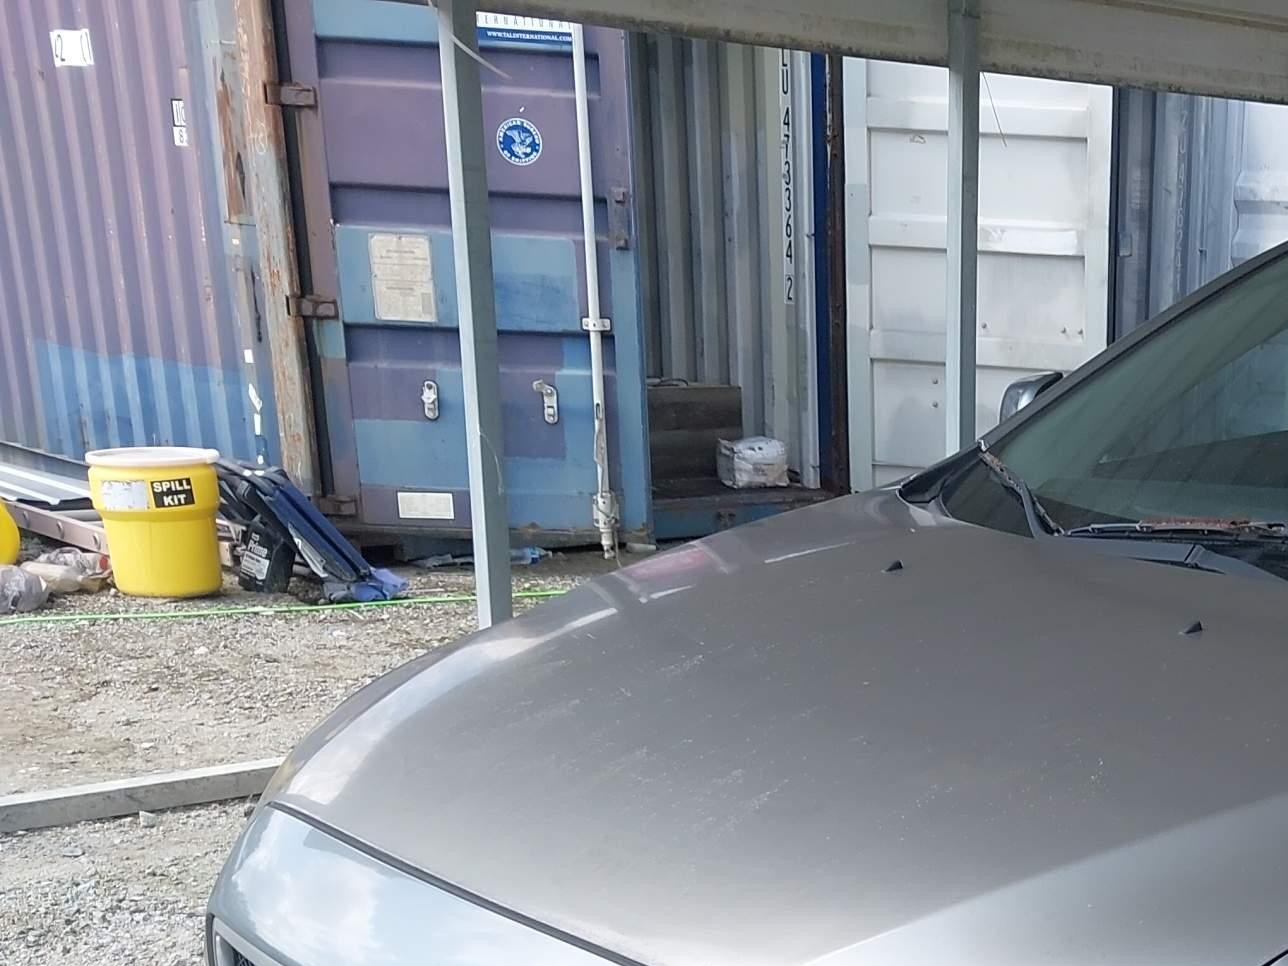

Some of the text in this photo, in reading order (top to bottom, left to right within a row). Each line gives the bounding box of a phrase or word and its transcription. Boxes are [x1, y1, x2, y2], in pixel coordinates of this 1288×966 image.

[783, 107, 793, 265] 473364
[153, 479, 191, 493] SPILL
[163, 494, 187, 506] KIT
